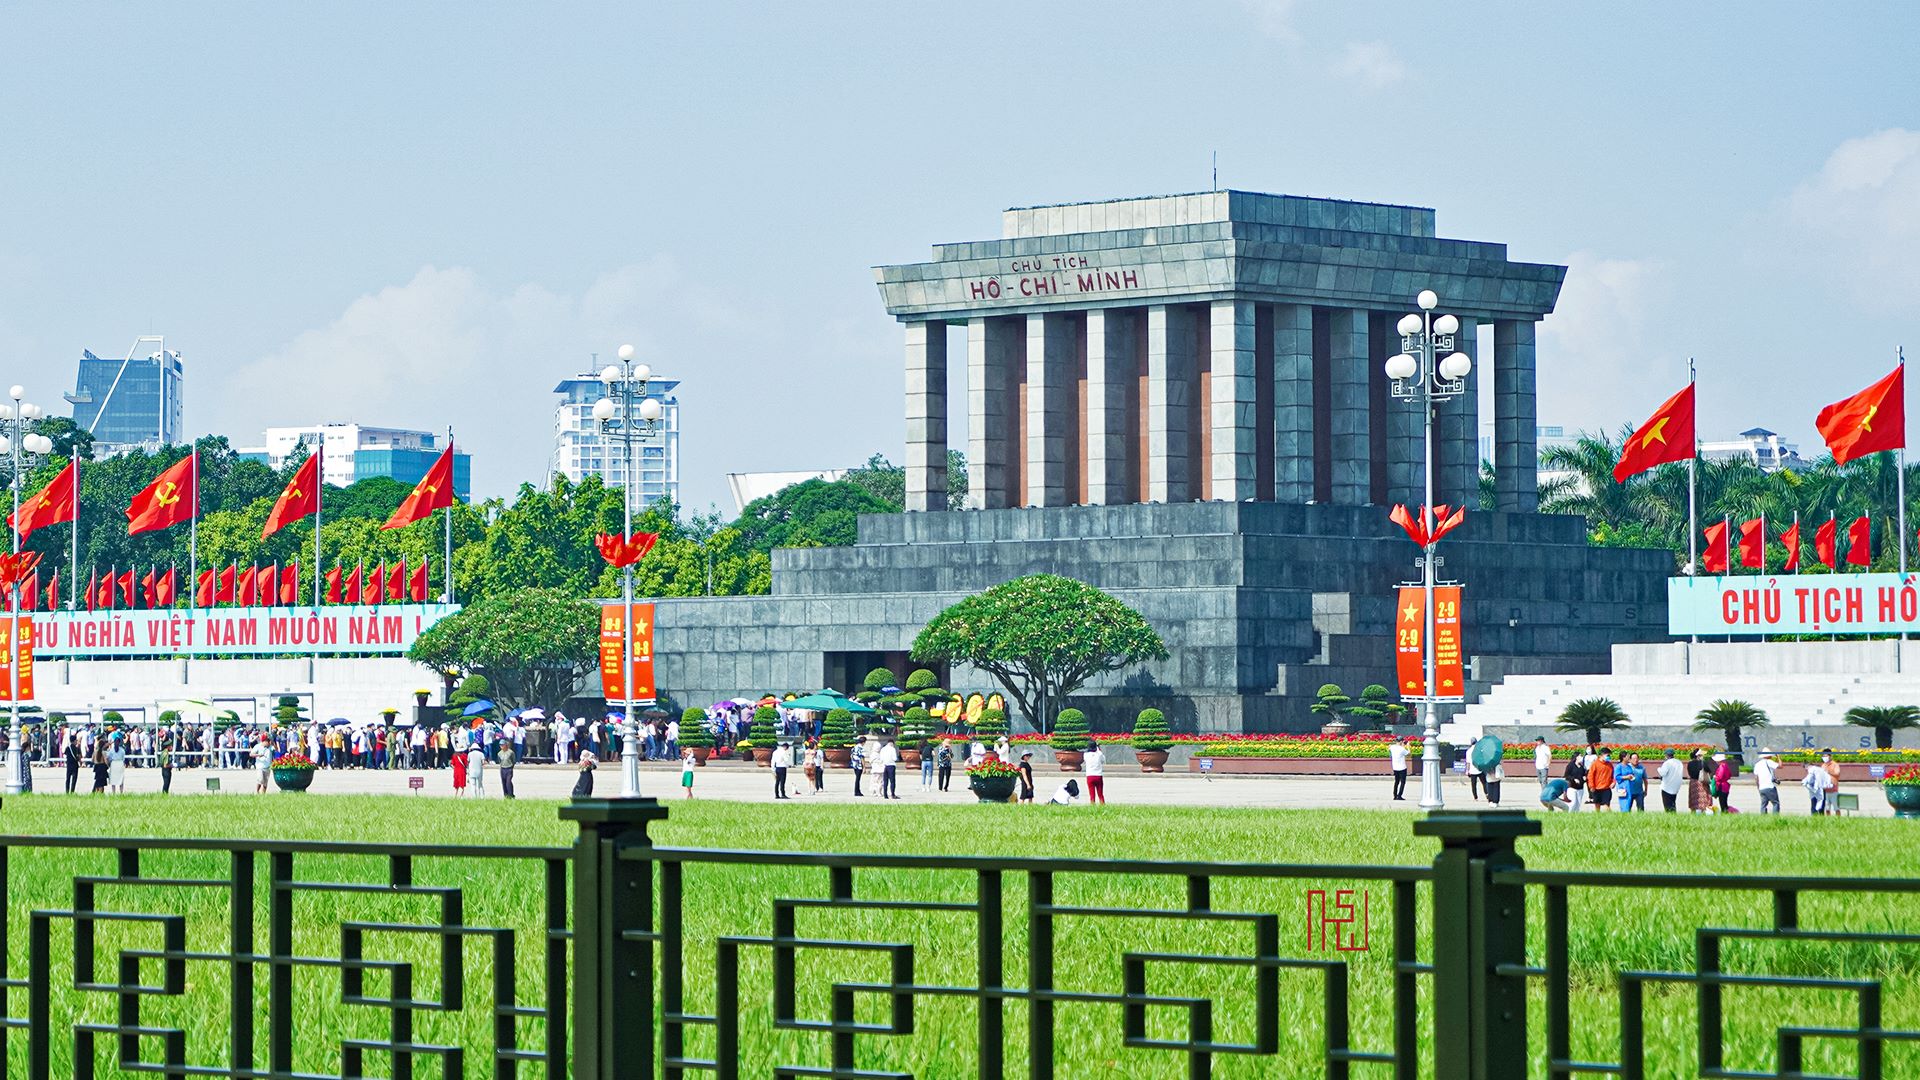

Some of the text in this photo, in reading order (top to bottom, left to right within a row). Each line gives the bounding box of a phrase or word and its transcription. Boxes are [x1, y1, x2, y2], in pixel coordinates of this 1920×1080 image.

[970, 274, 1001, 300] HỒ
[1020, 270, 1058, 297] CHÍ
[1437, 600, 1455, 618] 2-9
[1722, 574, 1918, 631] CHỦ TỊCH HỒ
[32, 613, 58, 649] HỦ
[69, 612, 136, 649] NGHĨA
[147, 612, 195, 651] VIỆT
[206, 618, 257, 646] NAM
[268, 611, 338, 645] MUÔN
[348, 610, 403, 643] NĂM
[1399, 628, 1419, 647] 2-9
